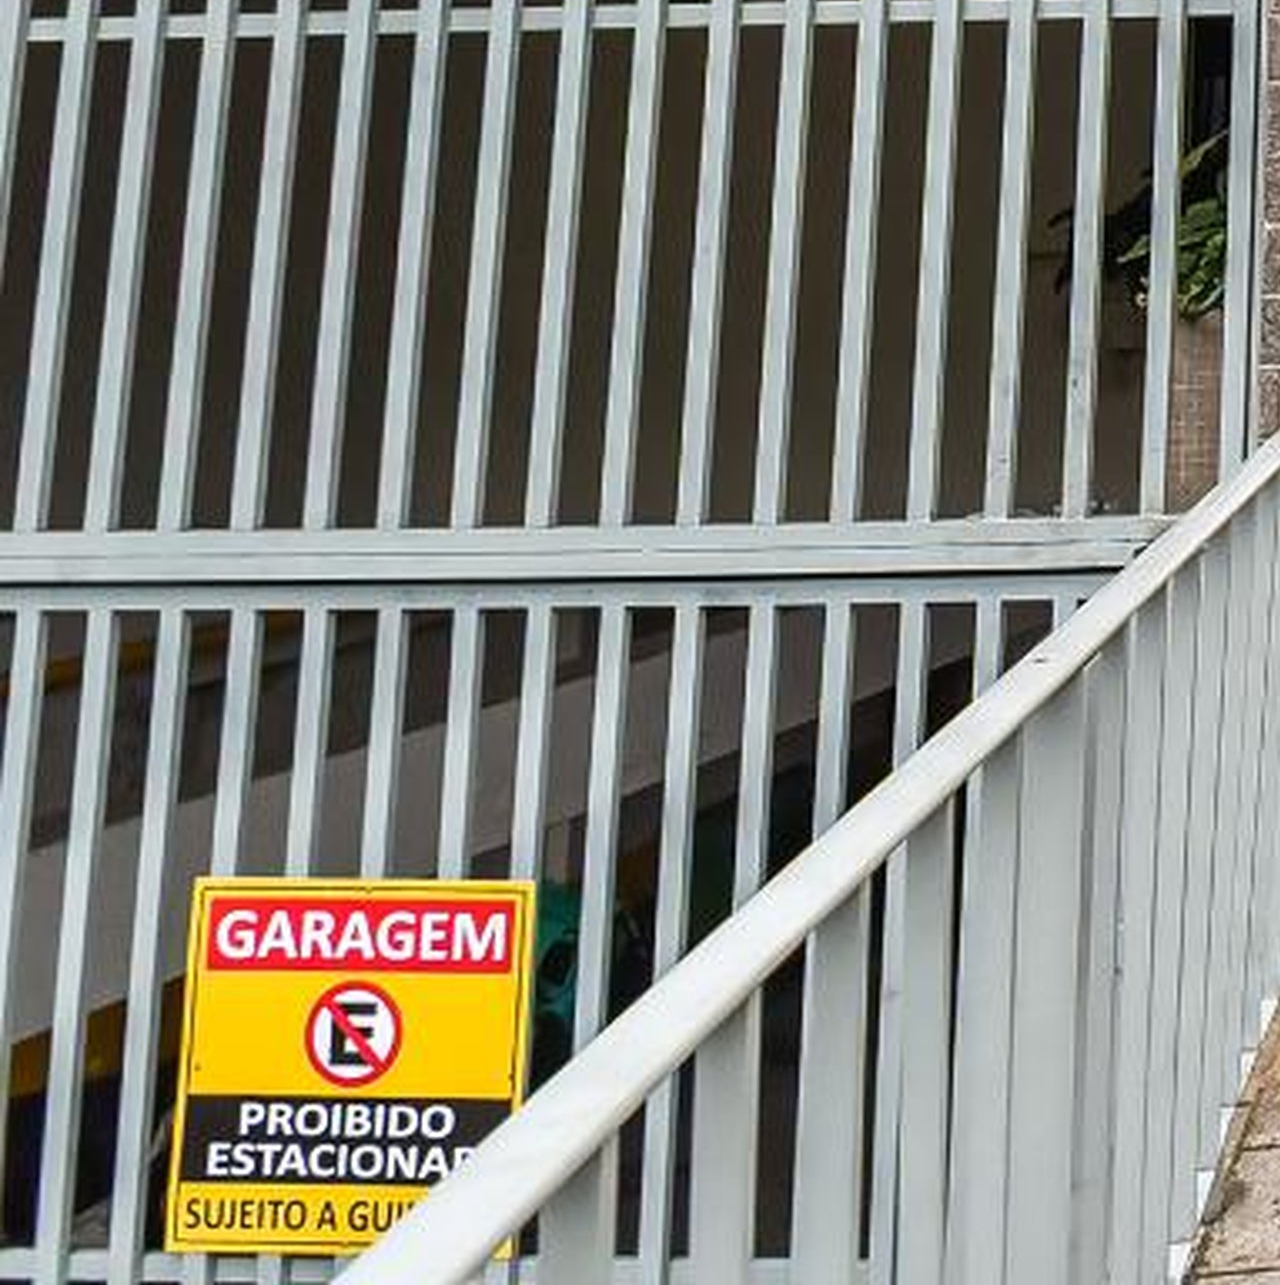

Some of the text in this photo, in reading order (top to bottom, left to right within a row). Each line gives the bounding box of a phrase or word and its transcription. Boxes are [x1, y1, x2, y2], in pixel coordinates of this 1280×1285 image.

[216, 908, 507, 962] GARAGEM
[239, 1102, 456, 1138] PROIBIDO
[186, 1197, 414, 1233] SUJEITO A GUI
